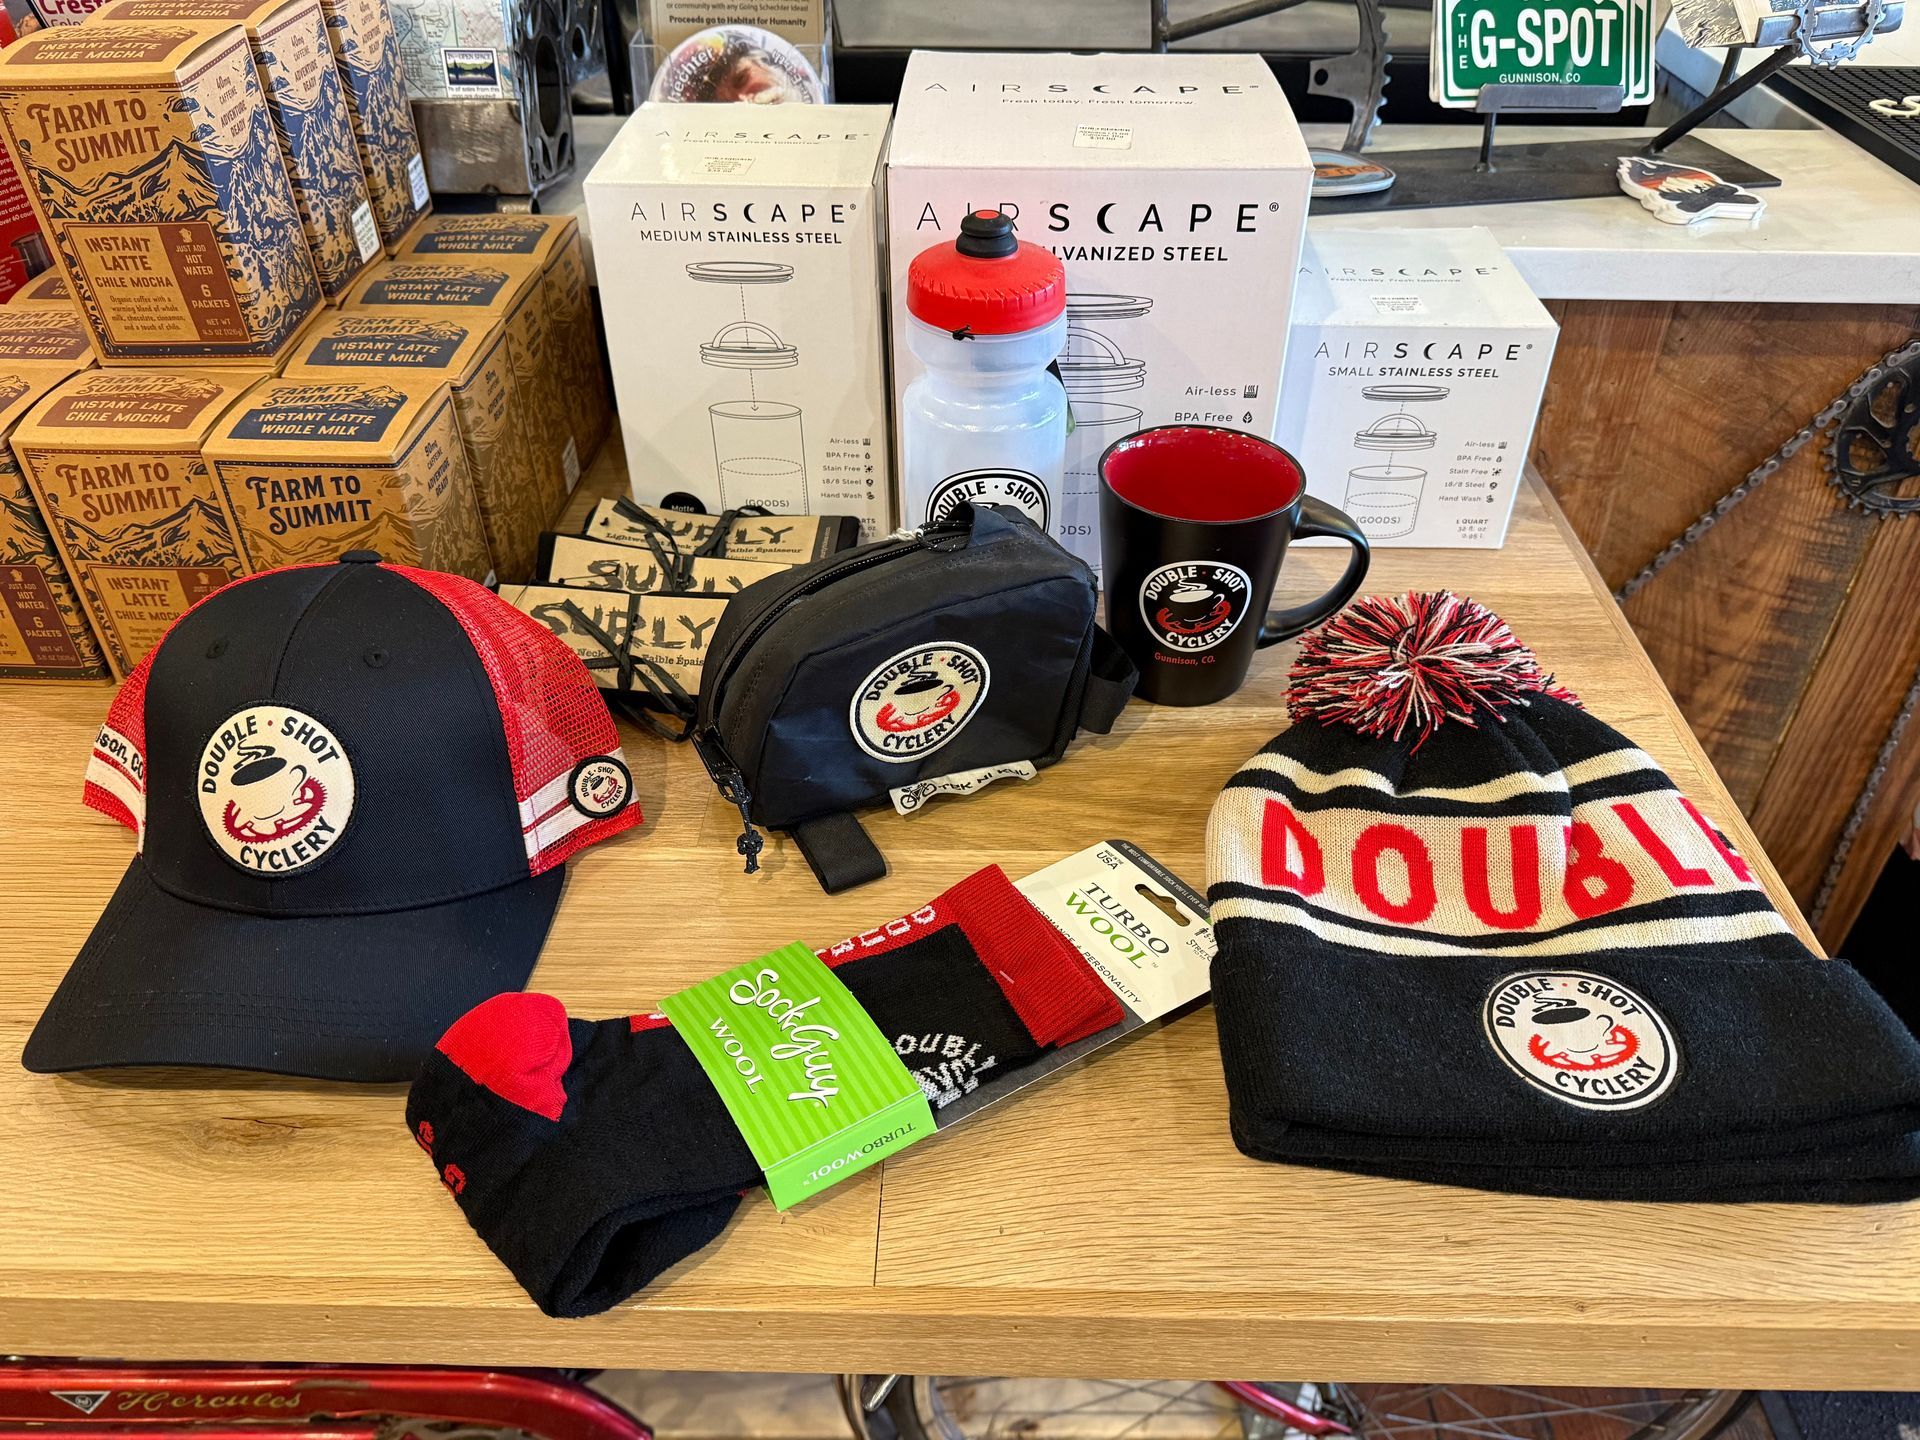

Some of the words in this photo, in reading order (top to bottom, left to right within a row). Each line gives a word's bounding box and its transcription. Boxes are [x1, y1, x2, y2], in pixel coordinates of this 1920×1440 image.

[669, 15, 705, 24] Proceeds
[706, 17, 716, 25] go
[717, 16, 725, 24] to
[727, 16, 756, 25] Habitat
[757, 17, 768, 25] for
[769, 16, 807, 27] Humanity
[1470, 9, 1618, 68] G-SPOT
[39, 42, 107, 50] INSTANT
[112, 42, 162, 50] LATTE
[34, 51, 81, 60] CHILE
[86, 50, 146, 59] MOCHA
[216, 76, 232, 90] 40mg
[303, 76, 317, 93] READY
[1499, 72, 1563, 85] GUNNISON,
[1566, 73, 1581, 83] CO
[219, 88, 238, 105] CAFFEINE
[26, 99, 112, 143] FARM
[113, 97, 147, 123] TO
[220, 100, 247, 128] ADVENTURE
[230, 120, 246, 137] READY
[54, 126, 161, 173] SUMMIT
[435, 234, 487, 242] INSTANT
[489, 234, 527, 243] LATTE
[641, 230, 702, 242] MEDIUM
[708, 231, 790, 244] STAINLESS
[795, 232, 842, 244] STEEL
[84, 236, 151, 253] INSTANT
[438, 242, 481, 250] WHOLE
[185, 254, 203, 264] HOT
[1163, 247, 1229, 261] STEEL
[100, 255, 152, 271] LATTE
[183, 266, 214, 276] WATER
[94, 276, 128, 288] CHILE
[129, 276, 174, 288] MOCHA
[200, 284, 212, 297] 6
[384, 283, 441, 292] INSTANT
[444, 284, 485, 294] LATTE
[387, 292, 433, 301] WHOLE
[436, 293, 472, 302] MILK
[191, 300, 231, 309] PACKETS
[338, 318, 398, 328] FARM
[399, 318, 421, 327] TO
[332, 325, 422, 337] SUMMIT
[36, 336, 80, 346] LATTE
[25, 346, 66, 355] SHOT
[332, 342, 393, 351] INSTANT
[395, 343, 442, 354] LATTE
[336, 352, 384, 362] WHOLE
[388, 353, 428, 363] MILK
[1328, 367, 1374, 377] SMALL
[1378, 367, 1452, 378] STAINLESS
[1457, 368, 1500, 378] STEEL
[83, 375, 146, 385] FARM
[147, 376, 177, 384] TO
[76, 384, 173, 396] SUMMIT
[272, 385, 335, 397] FARM
[336, 385, 358, 394] TO
[1185, 385, 1237, 396] Air-less
[262, 393, 357, 408] SUMMIT
[70, 401, 138, 410] INSTANT
[139, 401, 189, 413] LATTE
[65, 411, 111, 422] CHILE
[112, 413, 172, 423] MOCHA
[259, 413, 328, 422] INSTANT
[329, 413, 377, 424] LATTE
[1174, 412, 1200, 422] BPA
[1204, 412, 1233, 422] Free
[261, 424, 315, 435] WHOLE
[318, 425, 360, 436] MILK
[829, 437, 860, 446] Air-less
[1465, 441, 1496, 449] Air-less
[822, 465, 843, 473] Stain
[845, 465, 862, 473] Free
[55, 462, 136, 498] FARM
[138, 462, 170, 483] TO
[842, 478, 862, 486] Steel
[245, 475, 325, 510] FARM
[330, 475, 361, 495] TO
[820, 491, 839, 499] Hand
[841, 492, 863, 500] Wash
[1004, 482, 1040, 510] SHOT
[81, 486, 183, 523] SUMMIT
[671, 504, 695, 513] Matte
[745, 498, 790, 508] (GOODS)
[269, 499, 372, 535] SUMMIT
[1356, 516, 1401, 525] (GOODS)
[106, 577, 170, 592] INSTANT
[1145, 566, 1197, 600] DOUBLE
[1212, 568, 1246, 593] SHOT
[17, 591, 35, 600] HOT
[121, 593, 171, 607] LATTE
[16, 600, 46, 609] WATER
[114, 610, 146, 621] CHILE
[33, 616, 44, 628] 6
[25, 629, 62, 638] PACKETS
[1166, 618, 1233, 647] CYCLERY
[577, 648, 605, 658] Neck
[1154, 652, 1198, 665] Gunnison,
[1201, 655, 1216, 664] CO.
[866, 652, 935, 701] DOUBLE
[946, 654, 980, 685] SHOT
[883, 713, 956, 750] CYCLERY
[202, 715, 259, 794] DOUBLE
[281, 716, 340, 764] SHOT
[581, 770, 594, 798] DOUBLE
[598, 766, 615, 775] SHOT
[601, 785, 624, 809] CYCLERY
[240, 815, 336, 870] CYCLERY
[1096, 851, 1119, 870] USA
[1162, 874, 1175, 886] SOCK
[1187, 893, 1199, 905] EVER
[1086, 882, 1170, 954] TURBO
[1066, 891, 1148, 969] WOOL
[1082, 951, 1142, 1004] PERSONALITY
[1495, 978, 1554, 1028] DOUBLE
[1577, 980, 1643, 1017] SHOT
[709, 1017, 764, 1094] WOOL
[1555, 1056, 1656, 1096] CYCLERY
[117, 1391, 302, 1412] Hercules
